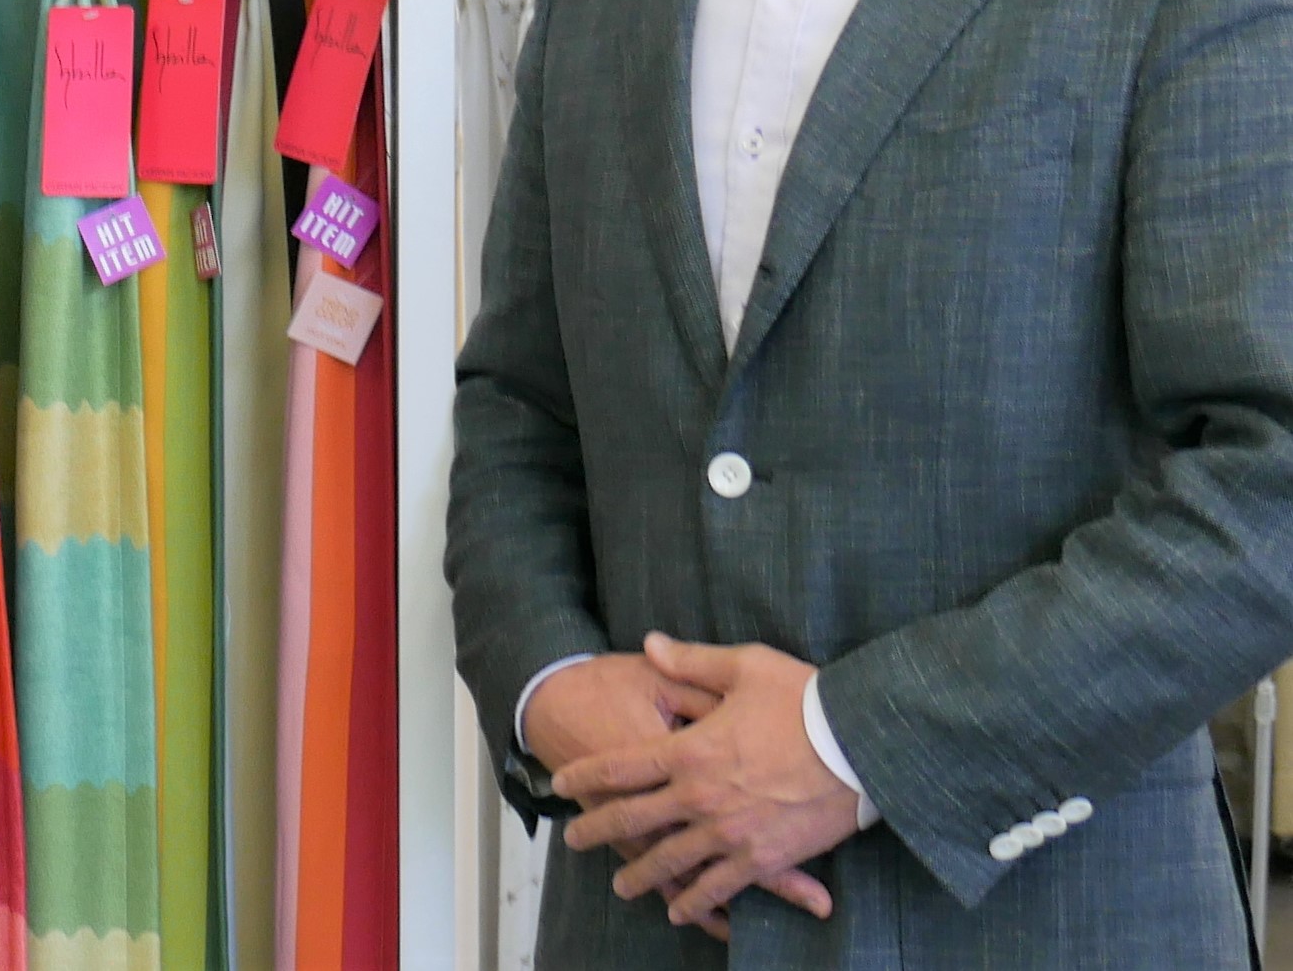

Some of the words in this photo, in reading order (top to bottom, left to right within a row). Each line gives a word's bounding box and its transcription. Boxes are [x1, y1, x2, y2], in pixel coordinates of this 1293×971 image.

[95, 211, 136, 249] HIT
[322, 191, 364, 229] HIT
[300, 209, 356, 259] ITEM
[98, 233, 157, 278] ITEM
